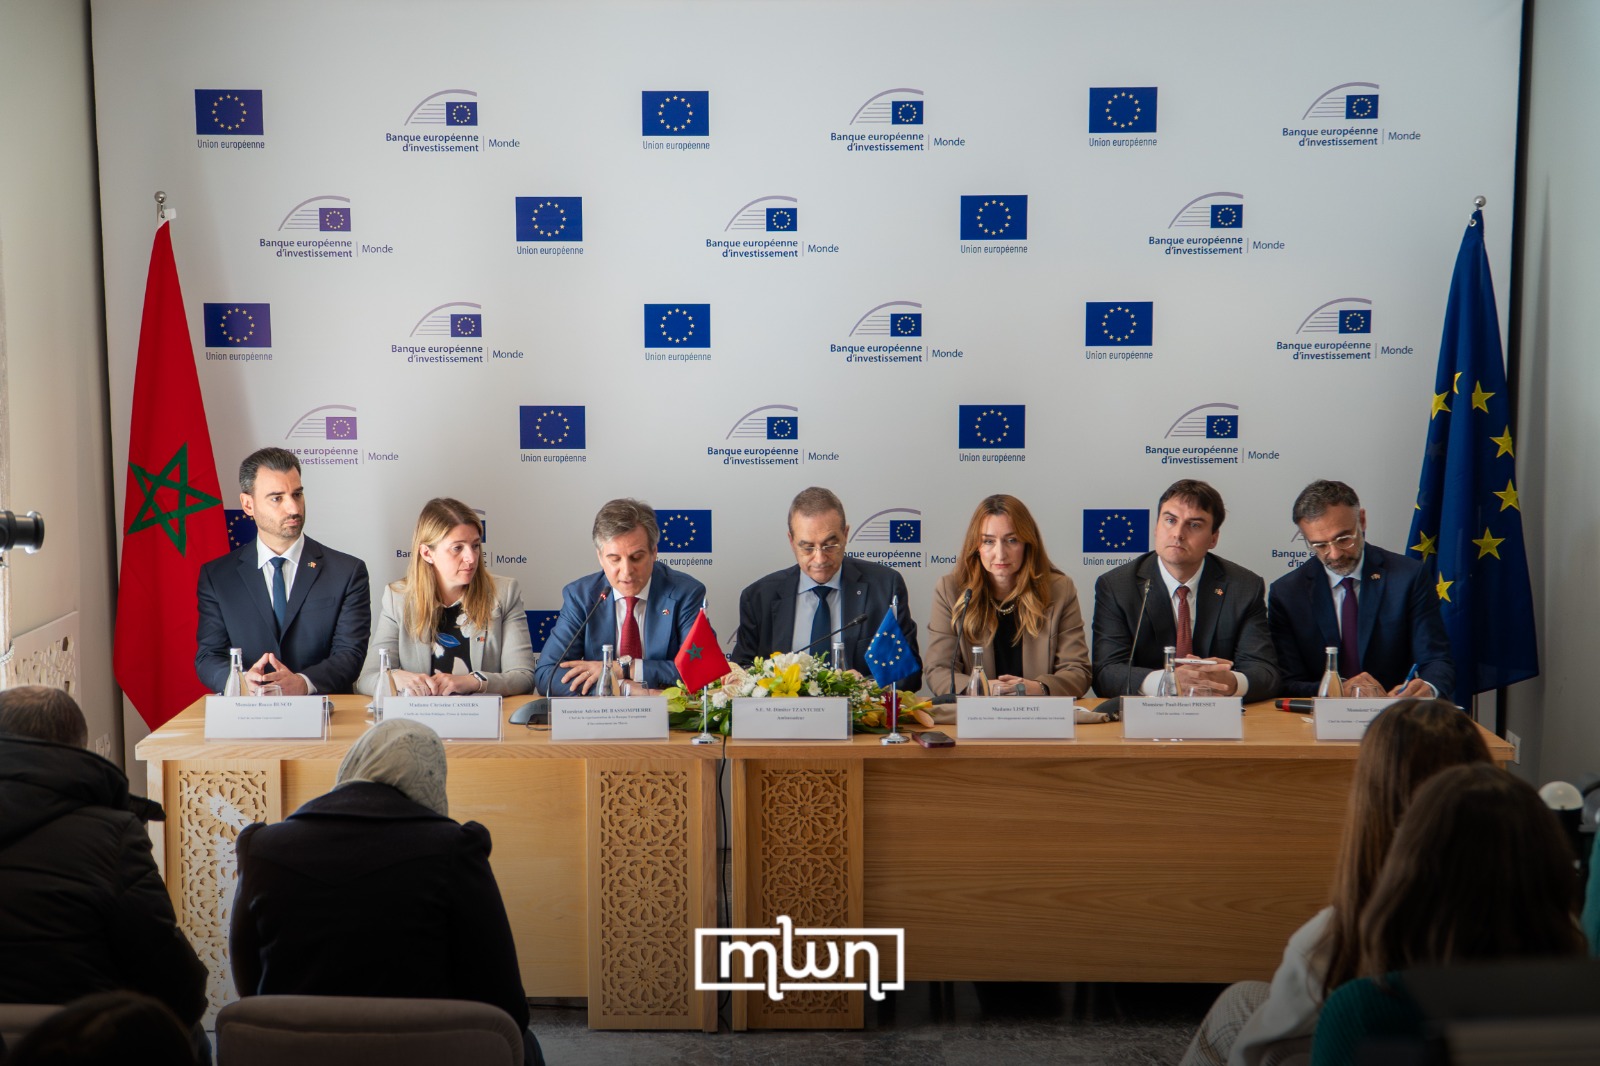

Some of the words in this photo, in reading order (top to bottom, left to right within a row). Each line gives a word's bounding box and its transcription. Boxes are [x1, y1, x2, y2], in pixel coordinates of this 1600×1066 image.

[830, 132, 866, 144] Banque
[868, 131, 925, 143] européenne
[1281, 127, 1318, 139] Banque
[1320, 125, 1379, 137] européenne
[1387, 130, 1422, 141] Monde
[385, 132, 421, 144] Banque
[423, 132, 480, 144] européenne
[488, 138, 521, 148] Monde
[933, 136, 966, 147] Monde
[1088, 137, 1111, 147] Union
[1112, 137, 1158, 149] européenne
[1298, 136, 1379, 146] d'investissement
[197, 138, 219, 149] Union
[221, 139, 266, 151] européenne
[402, 143, 480, 153] d'investissement
[642, 140, 665, 150] Union
[666, 140, 711, 152] européenne
[847, 142, 925, 152] d'investissement
[259, 238, 295, 250] Banque
[297, 238, 353, 250] européenne
[705, 238, 741, 250] Banque
[743, 238, 799, 250] européenne
[1148, 235, 1185, 247] Banque
[1187, 235, 1244, 247] européenne
[1252, 240, 1286, 250] Monde
[275, 248, 353, 258] d'investissement
[361, 243, 394, 254] Monde
[516, 245, 539, 255] Union
[540, 245, 584, 257] européenne
[721, 248, 799, 258] d'investissement
[807, 243, 840, 254] Monde
[960, 244, 982, 254] Union
[984, 244, 1029, 256] européenne
[1165, 245, 1244, 255] d'investissement
[391, 344, 427, 356] Banque
[428, 343, 484, 355] européenne
[829, 343, 865, 355] Banque
[867, 343, 923, 355] européenne
[1276, 341, 1313, 353] Banque
[1315, 340, 1372, 352] européenne
[1380, 345, 1414, 355] Monde
[205, 351, 228, 361] Union
[229, 351, 273, 363] européenne
[407, 353, 484, 363] d'investissement
[492, 349, 524, 359] Monde
[644, 352, 667, 361] Union
[668, 351, 712, 363] européenne
[845, 353, 923, 363] d'investissement
[931, 348, 964, 359] Monde
[1085, 350, 1108, 360] Union
[1109, 350, 1154, 362] européenne
[1293, 350, 1372, 360] d'investissement
[303, 446, 359, 457] européenne
[706, 446, 742, 458] Banque
[743, 446, 799, 458] européenne
[807, 451, 840, 461] Monde
[1145, 445, 1181, 457] Banque
[1183, 444, 1239, 456] européenne
[1247, 450, 1280, 460] Monde
[300, 457, 359, 465] vestissement
[367, 452, 399, 461] Monde
[520, 453, 542, 463] Union
[544, 453, 587, 465] européenne
[722, 455, 799, 465] d'investissement
[958, 452, 981, 463] Union
[982, 452, 1026, 464] européenne
[1161, 454, 1239, 464] d'investissement
[496, 554, 528, 564] Monde
[866, 550, 922, 560] européenne
[930, 555, 957, 564] Mond
[1271, 550, 1308, 561] Banque
[669, 557, 713, 567] européenne
[1083, 557, 1104, 566] Union
